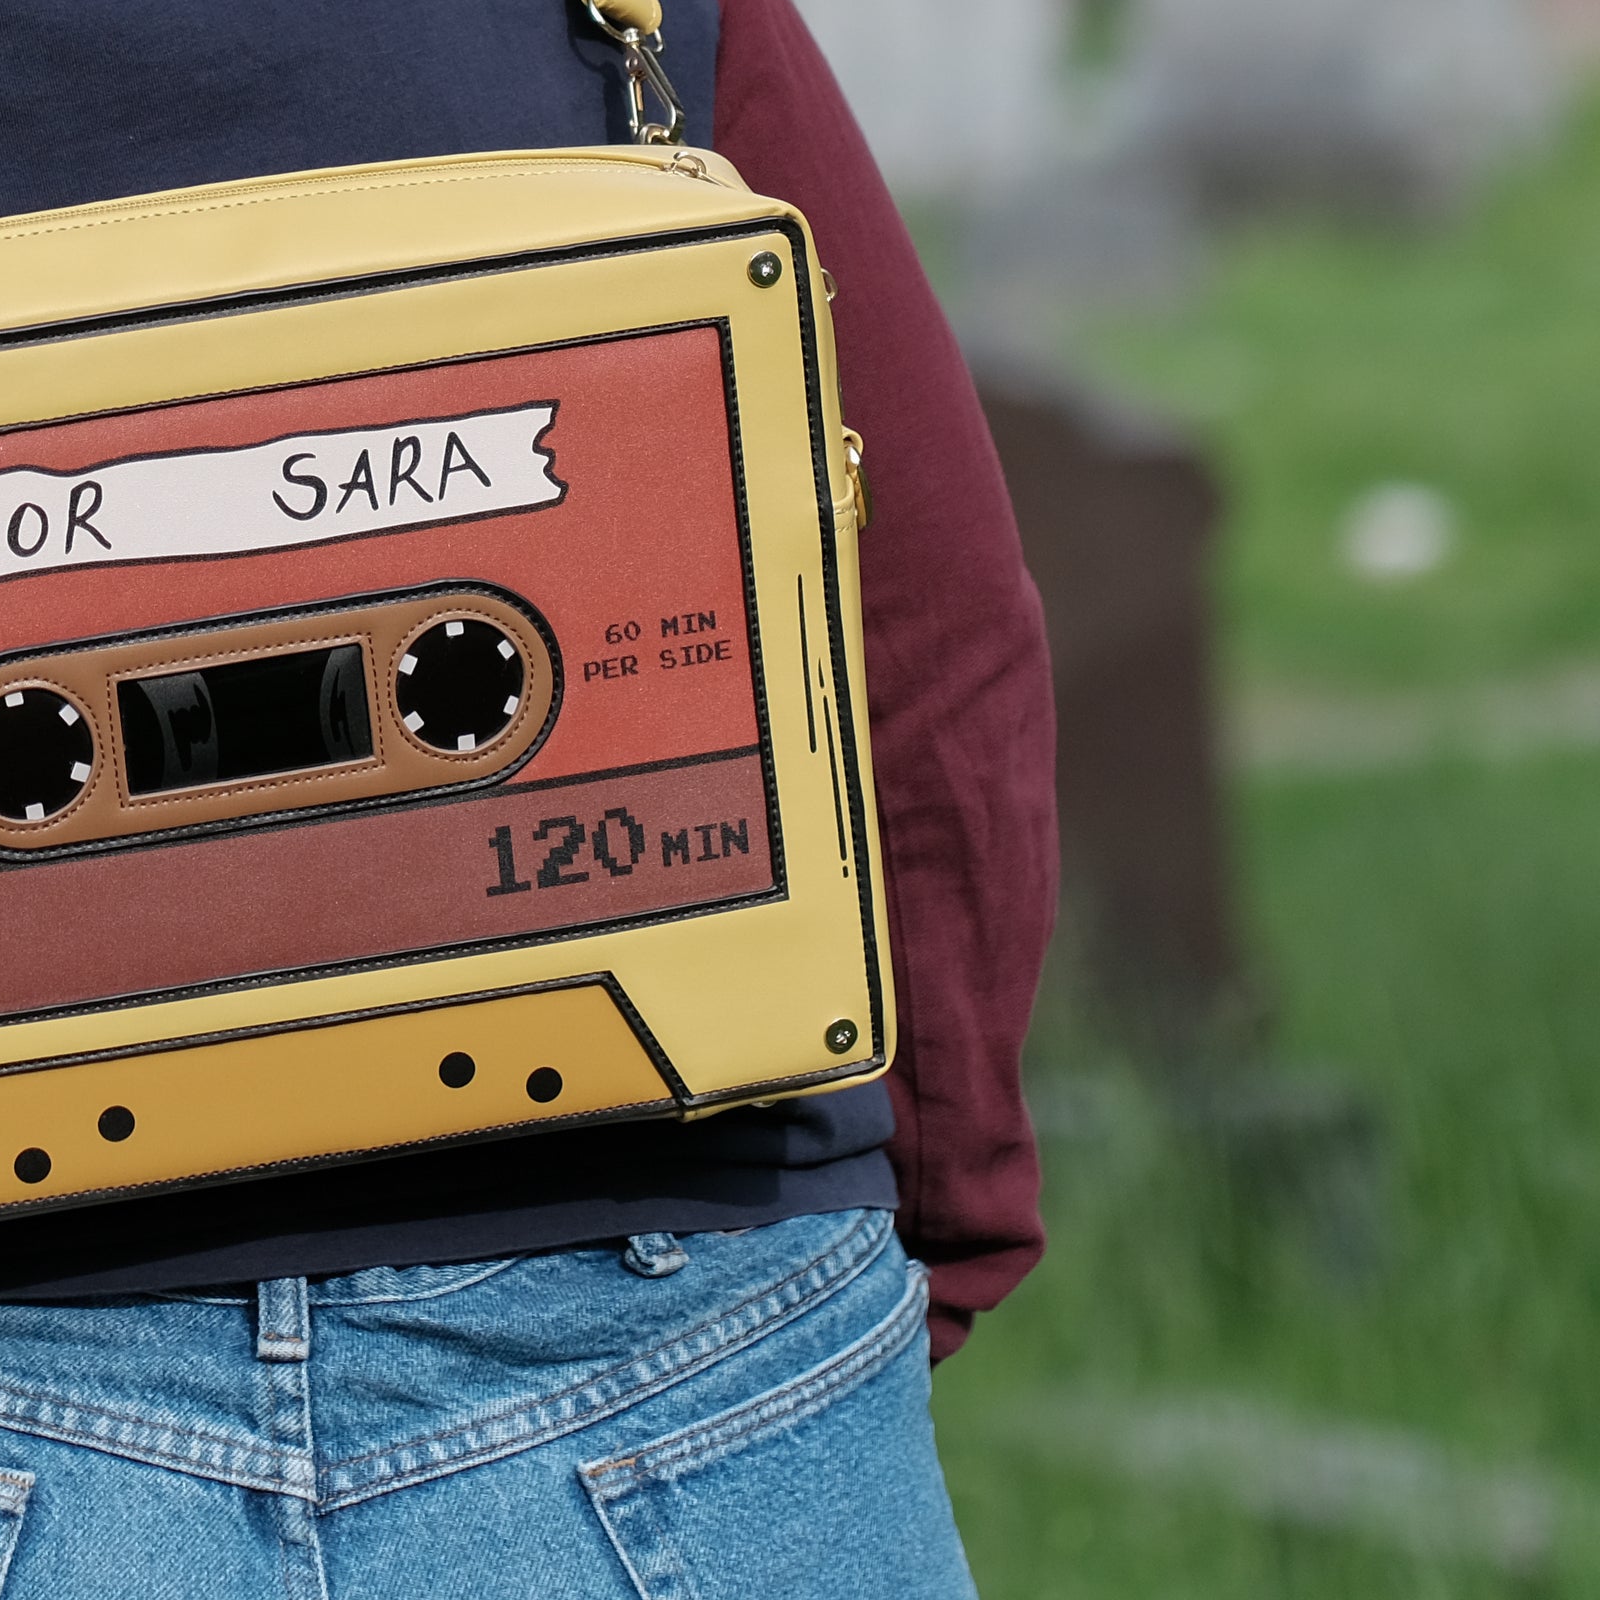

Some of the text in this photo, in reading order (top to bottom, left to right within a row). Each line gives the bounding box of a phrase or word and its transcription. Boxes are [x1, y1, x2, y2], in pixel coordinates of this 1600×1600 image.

[272, 431, 493, 520] SARA
[583, 639, 733, 682] PER SIDE
[605, 610, 717, 645] 60 MIN
[485, 806, 750, 898] 120 MIN
